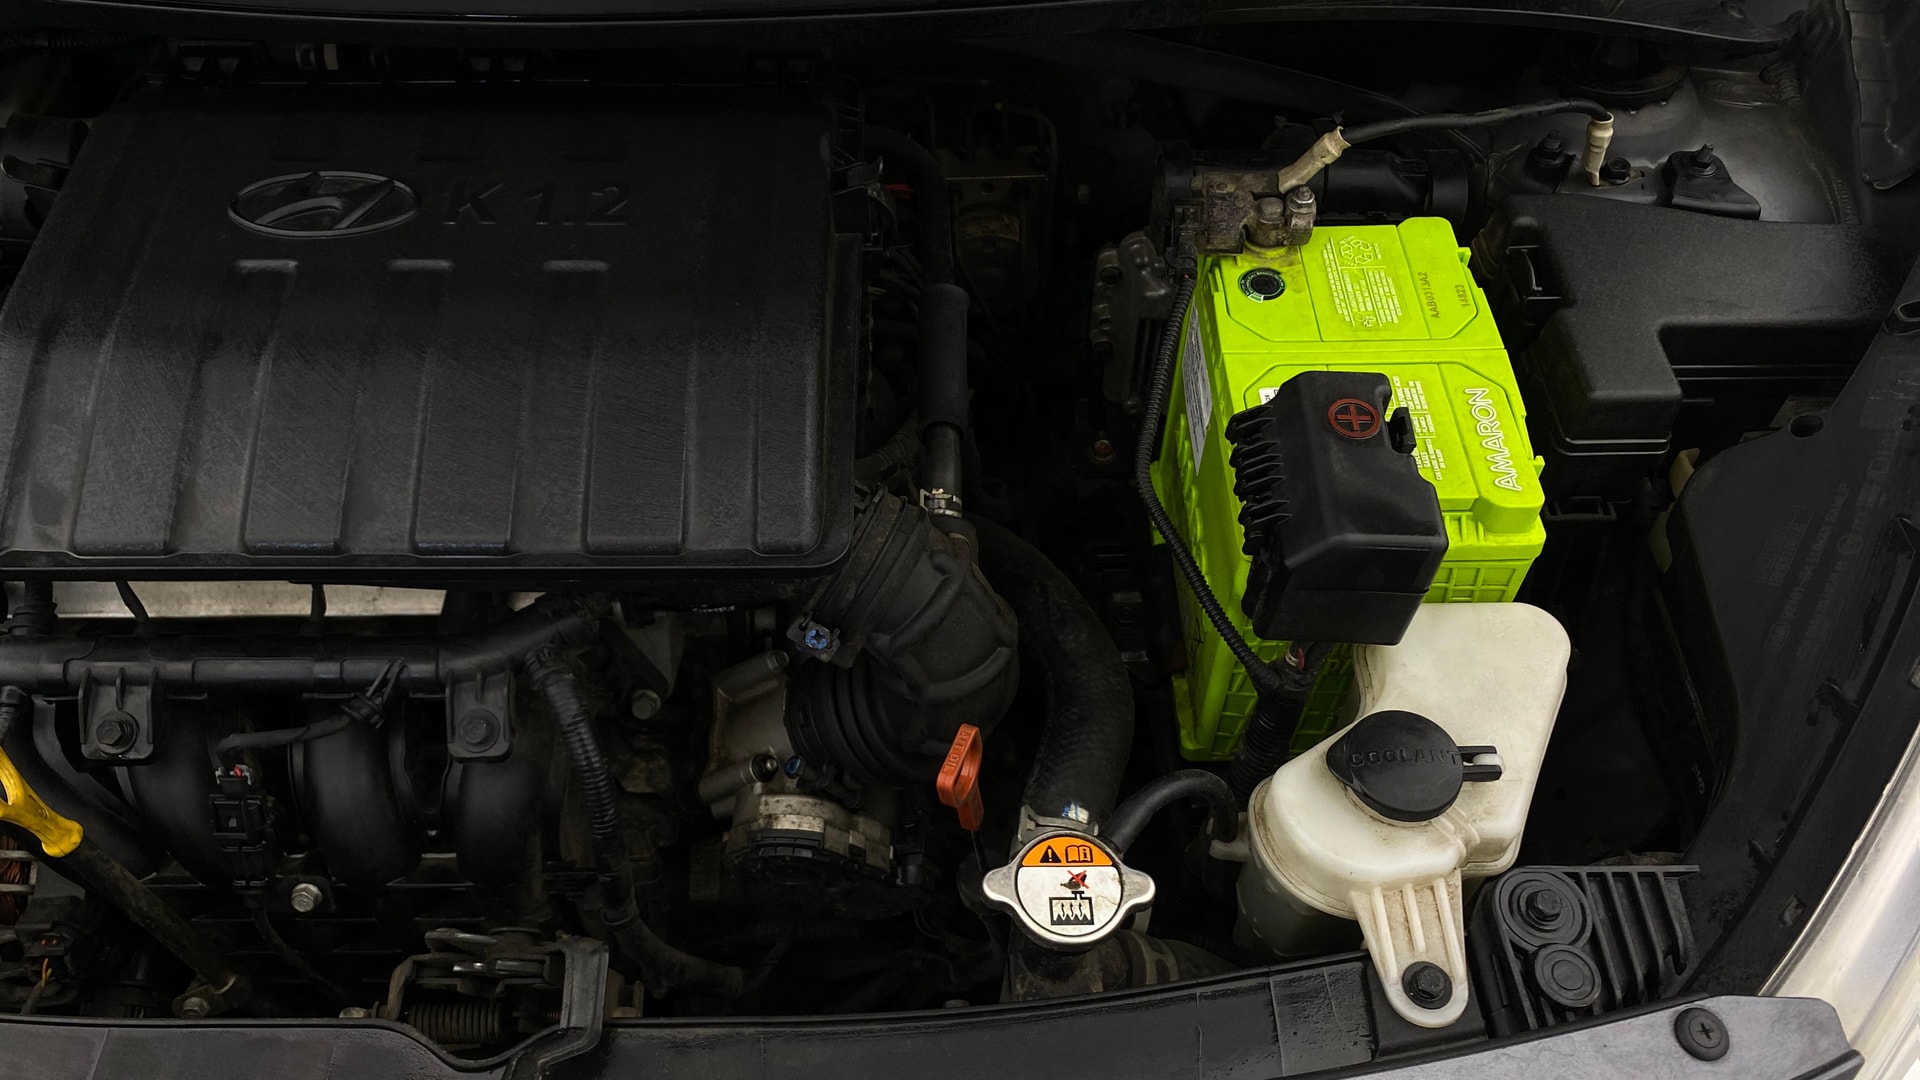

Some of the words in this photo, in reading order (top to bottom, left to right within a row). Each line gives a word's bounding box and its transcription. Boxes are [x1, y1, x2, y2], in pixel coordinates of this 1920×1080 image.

[443, 183, 502, 225] K
[526, 183, 631, 226] 1.2
[1465, 388, 1523, 491] AMARON
[943, 753, 960, 772] OIL
[1352, 750, 1463, 768] COOLANT
